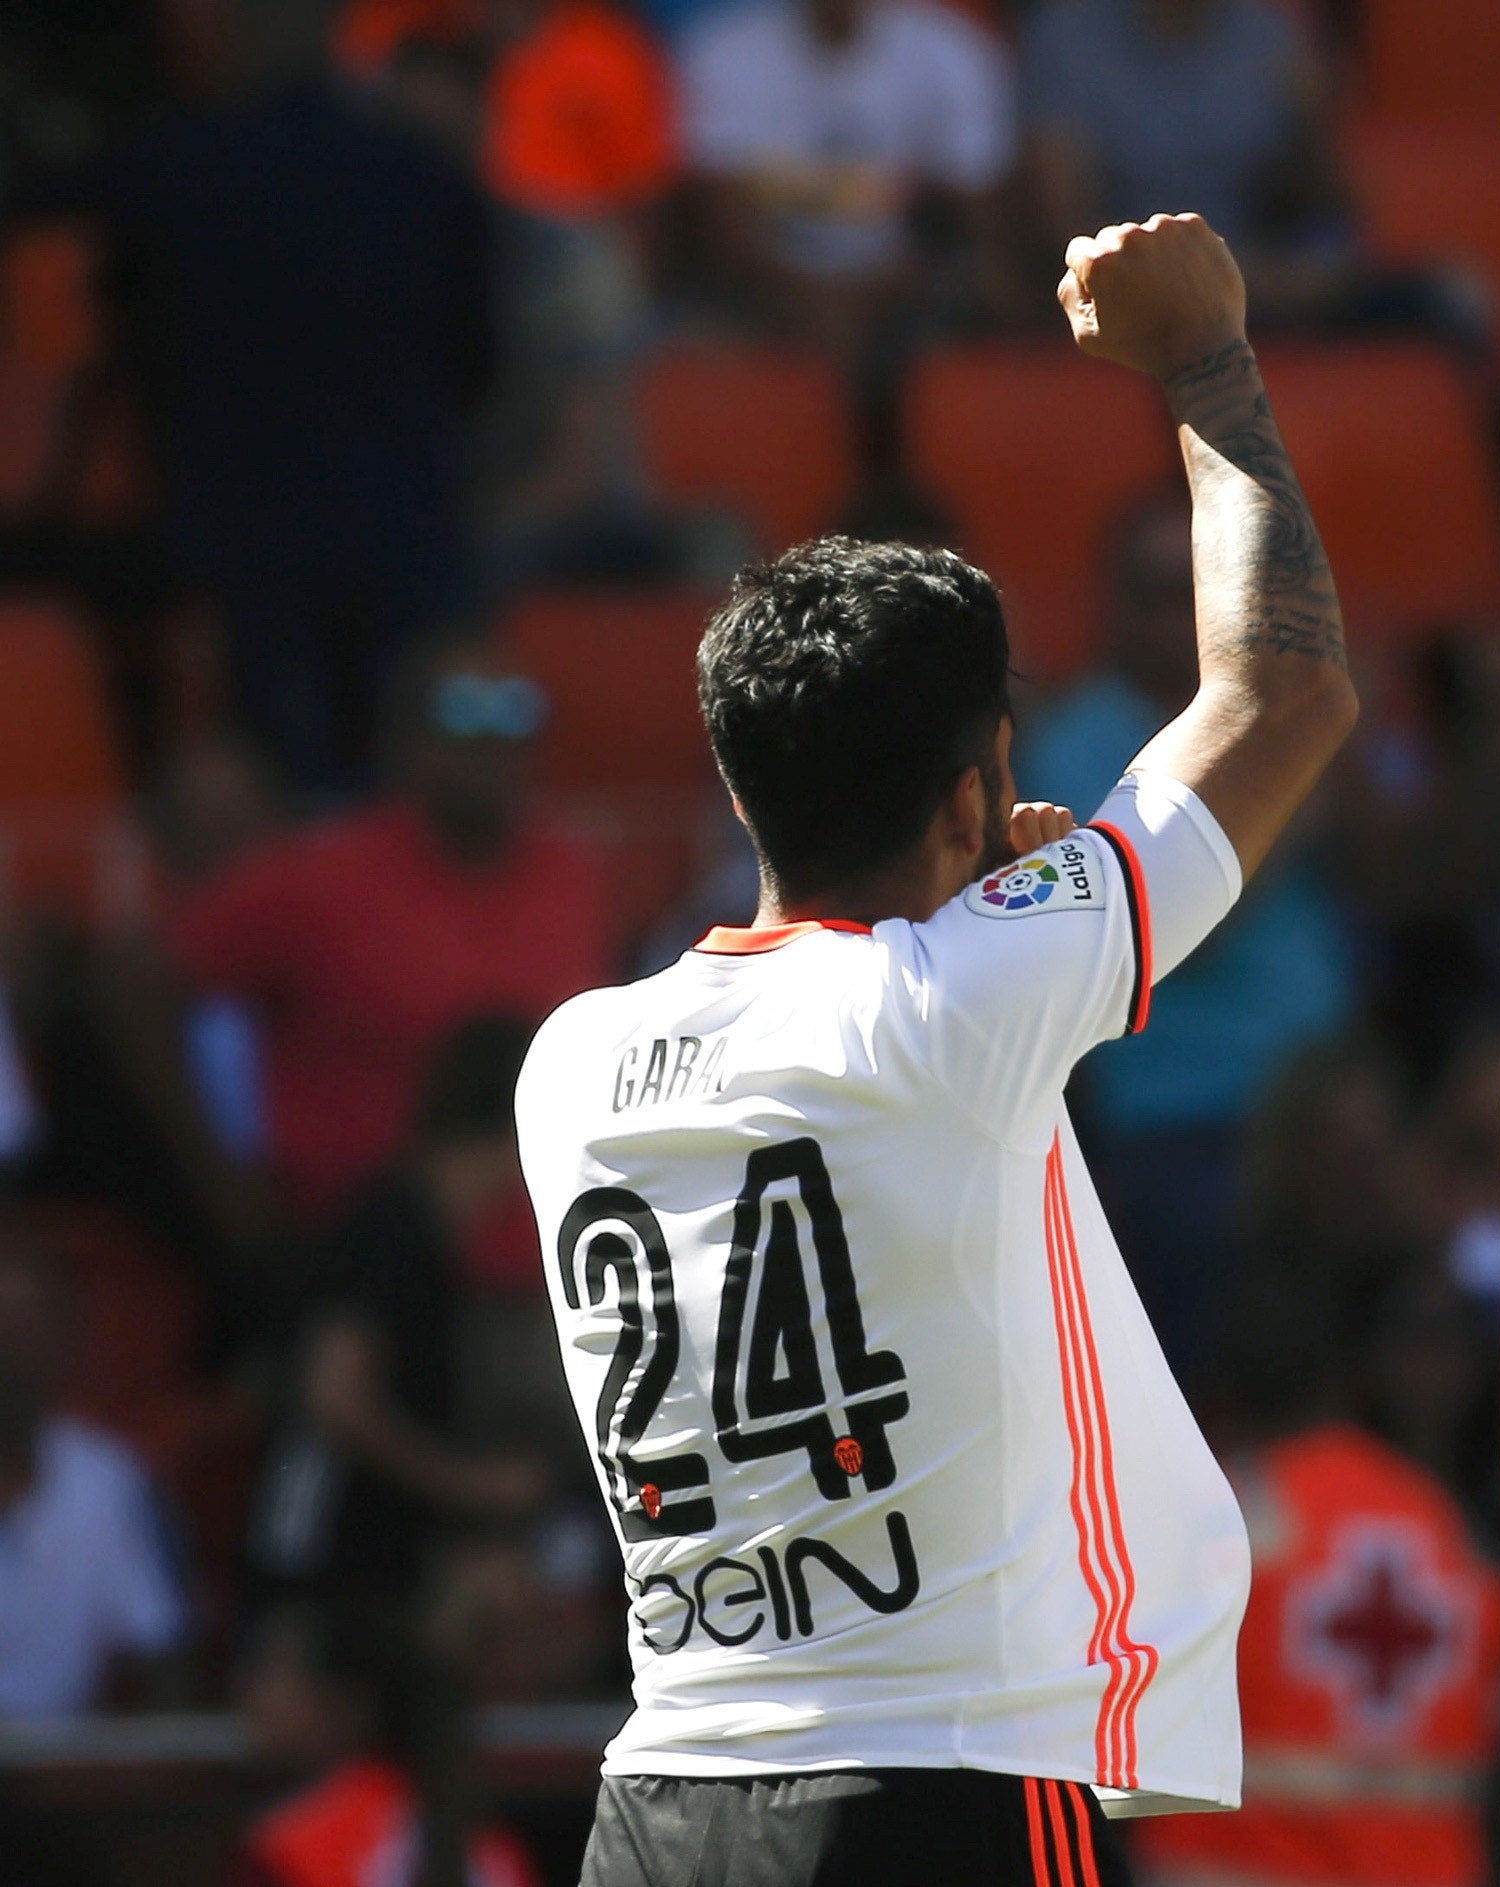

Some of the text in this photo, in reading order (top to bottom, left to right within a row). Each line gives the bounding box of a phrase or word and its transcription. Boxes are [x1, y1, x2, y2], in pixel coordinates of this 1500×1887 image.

[1061, 844, 1092, 900] LaLiga
[612, 1036, 729, 1113] GARA
[557, 1136, 910, 1543] 24
